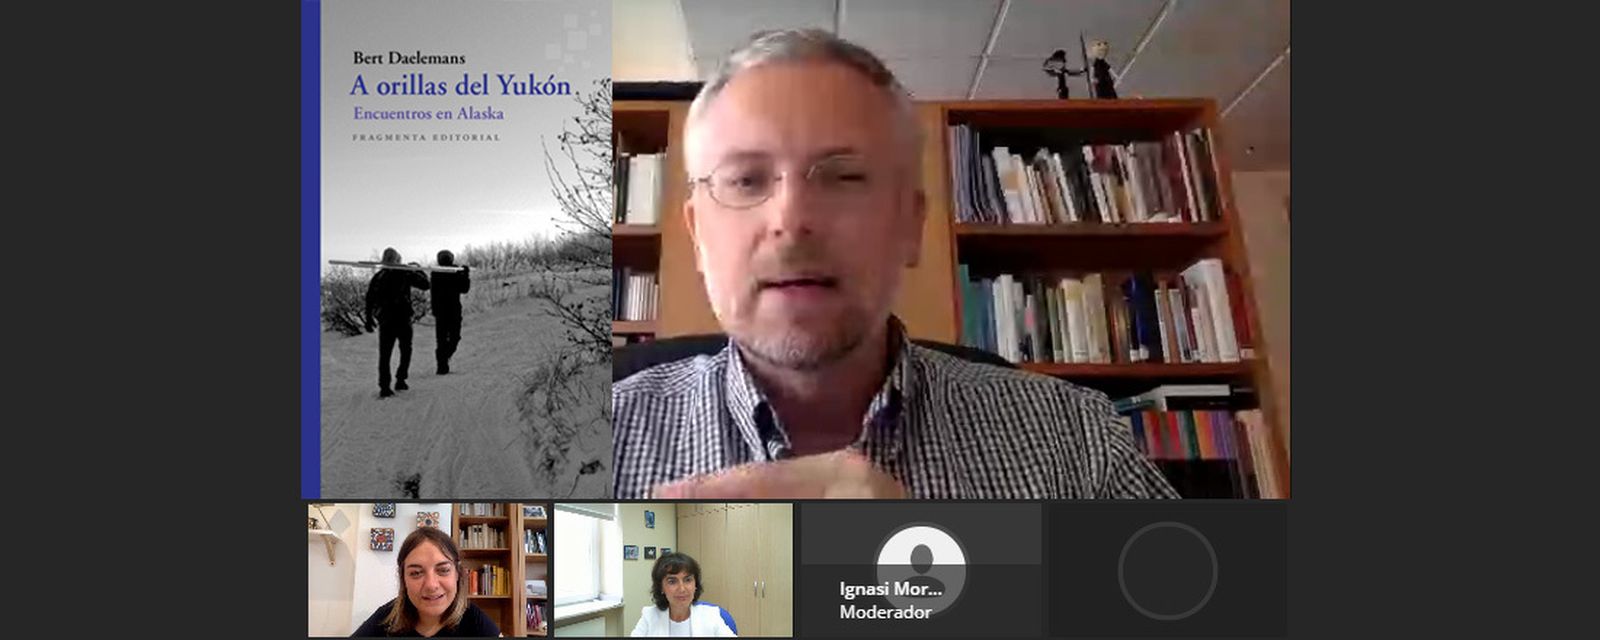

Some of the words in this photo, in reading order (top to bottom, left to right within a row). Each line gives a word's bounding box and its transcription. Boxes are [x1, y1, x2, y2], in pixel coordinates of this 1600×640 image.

[353, 51, 383, 65] Bert
[388, 51, 466, 65] Daelemans
[350, 73, 369, 95] A
[376, 73, 448, 95] orillas
[455, 72, 489, 95] del
[496, 73, 572, 95] Yukón
[353, 106, 432, 120] Encuentros
[435, 109, 453, 120] en
[457, 106, 505, 120] Alaska
[352, 134, 427, 142] FRAGMENTA
[432, 134, 501, 142] EDITORIAL
[839, 581, 890, 600] Ignasi
[894, 581, 943, 597] Mor...
[839, 604, 933, 620] Moderador
